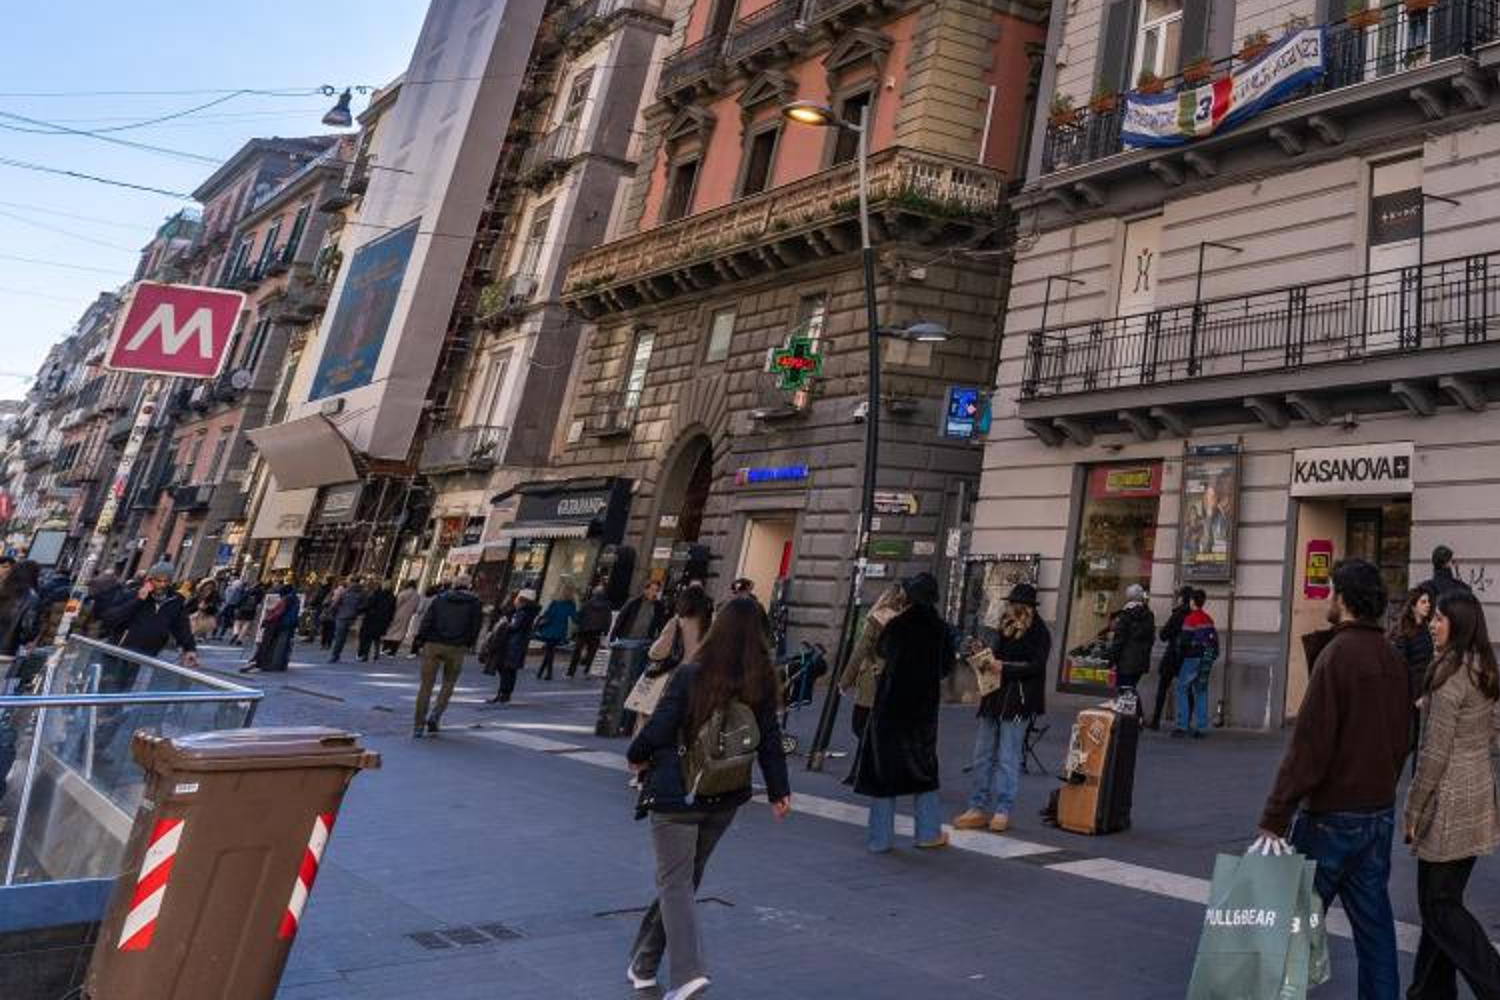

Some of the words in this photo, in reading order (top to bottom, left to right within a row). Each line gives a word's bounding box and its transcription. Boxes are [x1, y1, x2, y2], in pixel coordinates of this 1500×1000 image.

[1196, 96, 1212, 120] 3
[125, 303, 213, 359] M
[1294, 457, 1393, 484] KASANOVA
